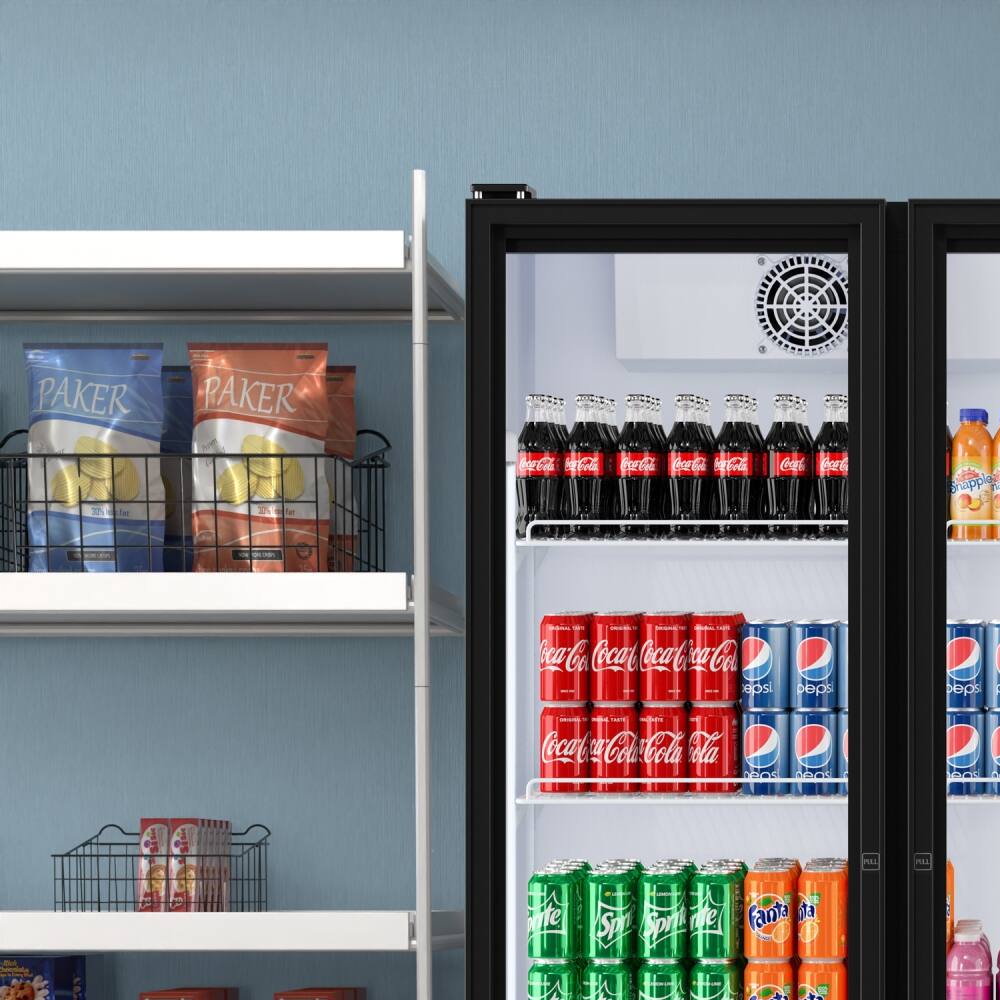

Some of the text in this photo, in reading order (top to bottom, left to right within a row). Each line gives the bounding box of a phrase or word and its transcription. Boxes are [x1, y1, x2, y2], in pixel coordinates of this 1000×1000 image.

[38, 377, 131, 415] PAKER
[204, 376, 296, 414] PAKER
[951, 473, 992, 494] Snapple
[797, 682, 833, 696] pepsi
[528, 902, 561, 931] prite
[748, 901, 789, 932] Fanta
